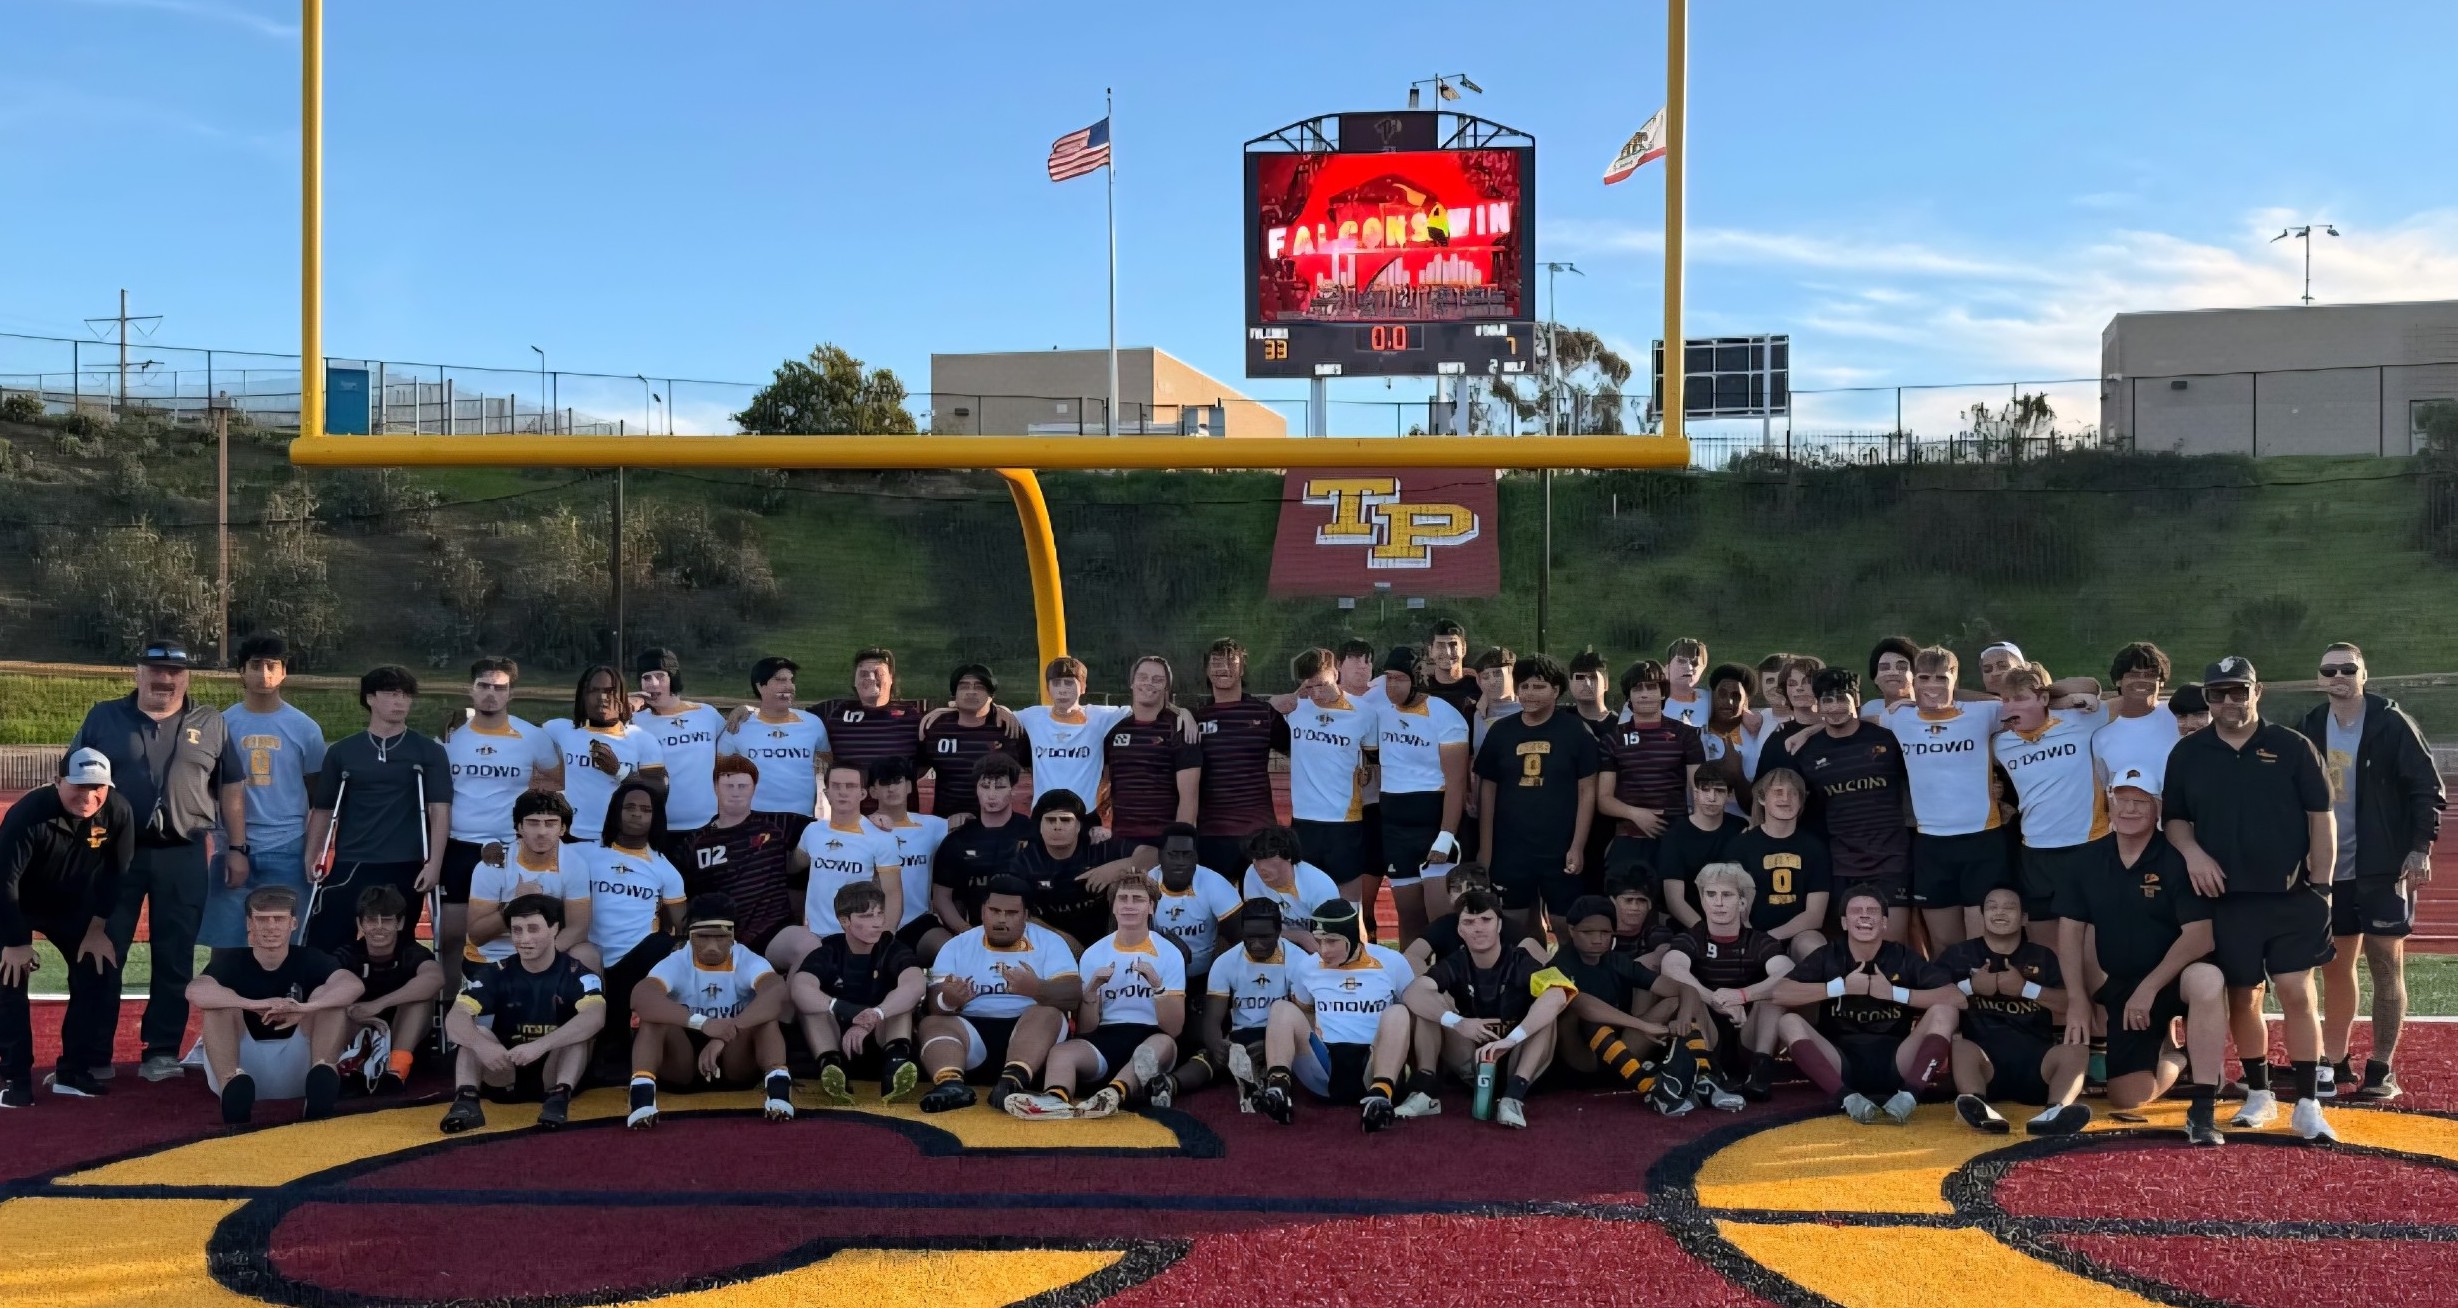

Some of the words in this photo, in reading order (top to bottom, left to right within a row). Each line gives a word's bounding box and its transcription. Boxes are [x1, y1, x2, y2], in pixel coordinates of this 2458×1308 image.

[1268, 212, 1430, 259] FALCONS
[1303, 477, 1479, 569] TP
[937, 739, 957, 754] 01
[1623, 731, 1640, 746] 15
[2007, 743, 2077, 770] O'DOWD
[697, 845, 728, 869] 02
[1477, 1075, 1491, 1088] G
